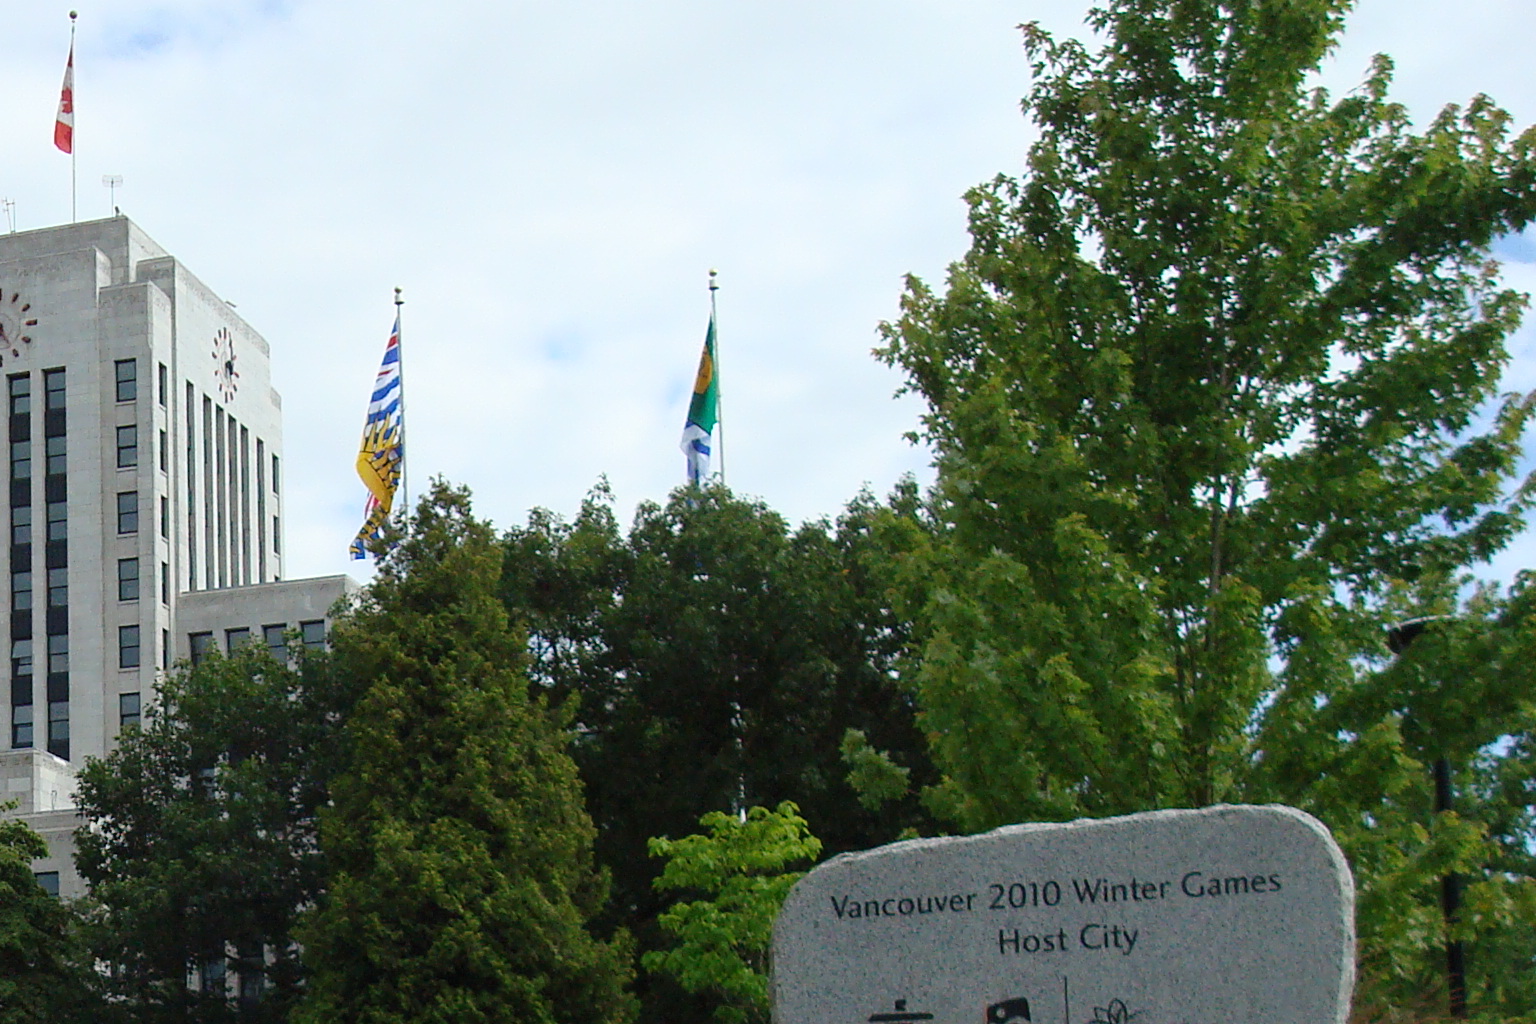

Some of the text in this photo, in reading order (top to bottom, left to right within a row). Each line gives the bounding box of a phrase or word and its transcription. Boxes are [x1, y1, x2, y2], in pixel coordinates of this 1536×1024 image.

[830, 871, 1282, 919] Vancouver 2010 Winter Games
[998, 923, 1138, 956] Host City
